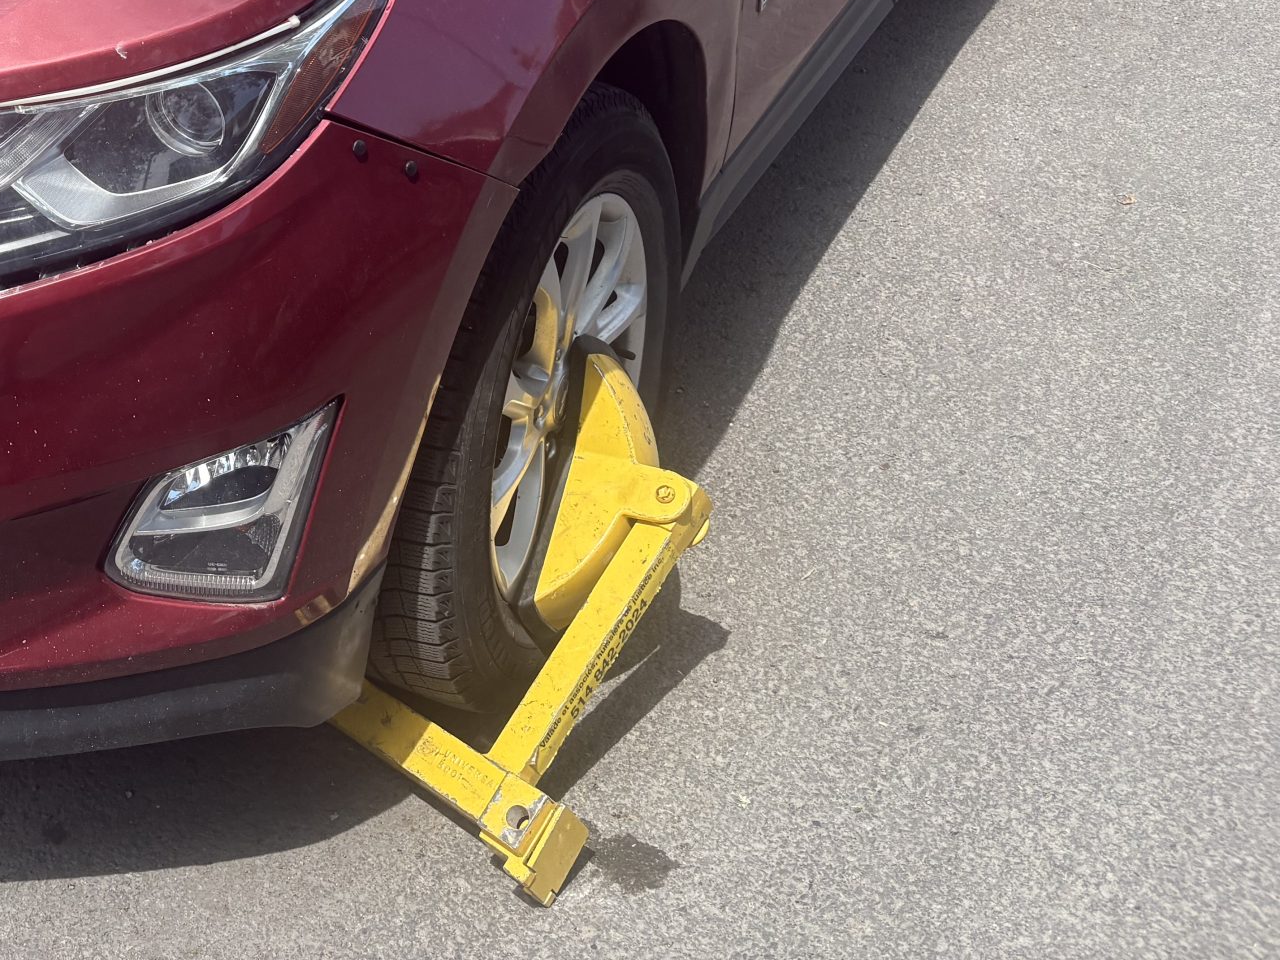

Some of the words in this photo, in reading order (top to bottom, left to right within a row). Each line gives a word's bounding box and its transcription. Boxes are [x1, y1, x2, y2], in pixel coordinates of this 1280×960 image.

[540, 717, 562, 748] Valade
[562, 706, 570, 716] et
[632, 573, 652, 605] justice
[570, 685, 593, 719] 514
[594, 598, 648, 682] 842-2024
